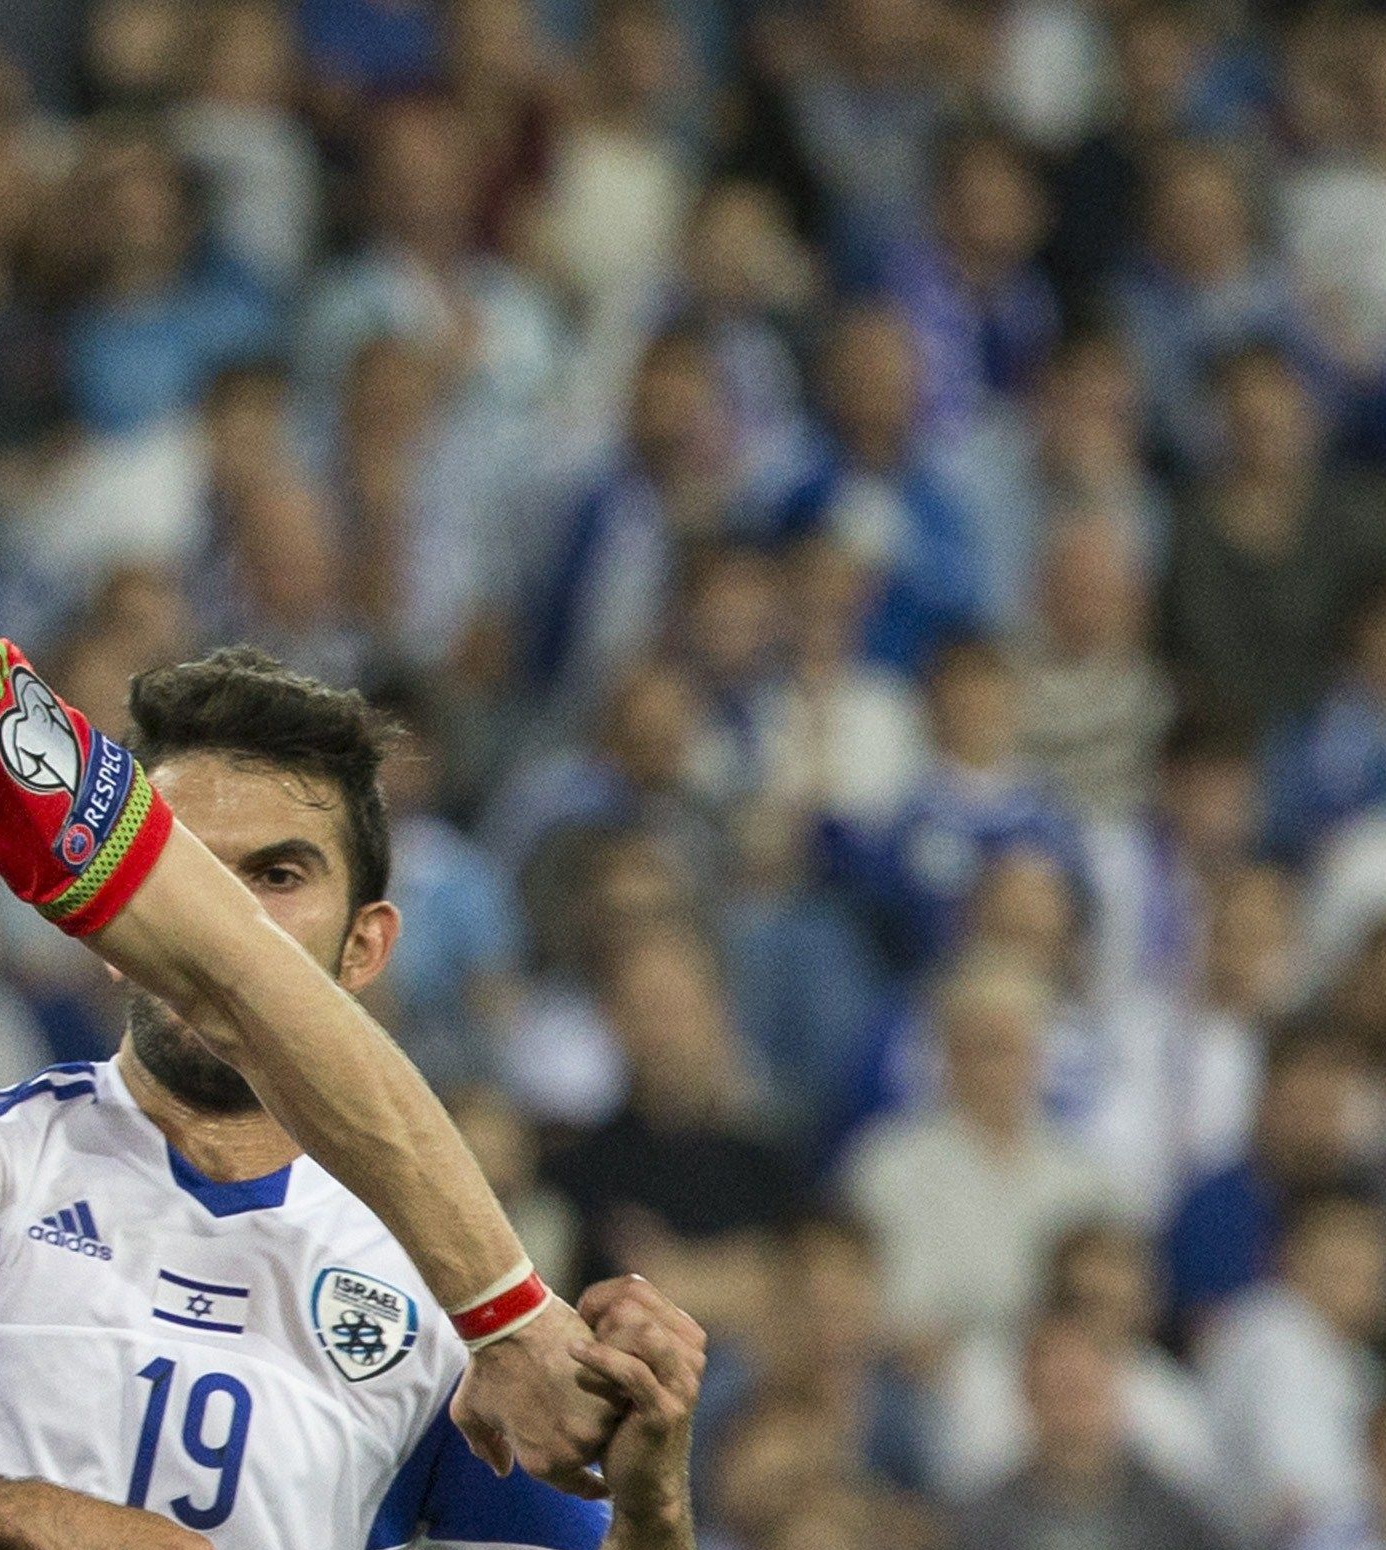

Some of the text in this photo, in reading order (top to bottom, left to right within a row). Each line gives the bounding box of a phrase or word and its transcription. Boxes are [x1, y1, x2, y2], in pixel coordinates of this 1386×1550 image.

[83, 736, 124, 828] RESPECT
[28, 1225, 113, 1262] adidas
[334, 1275, 402, 1313] ISRAEL
[127, 1355, 254, 1531] 19
